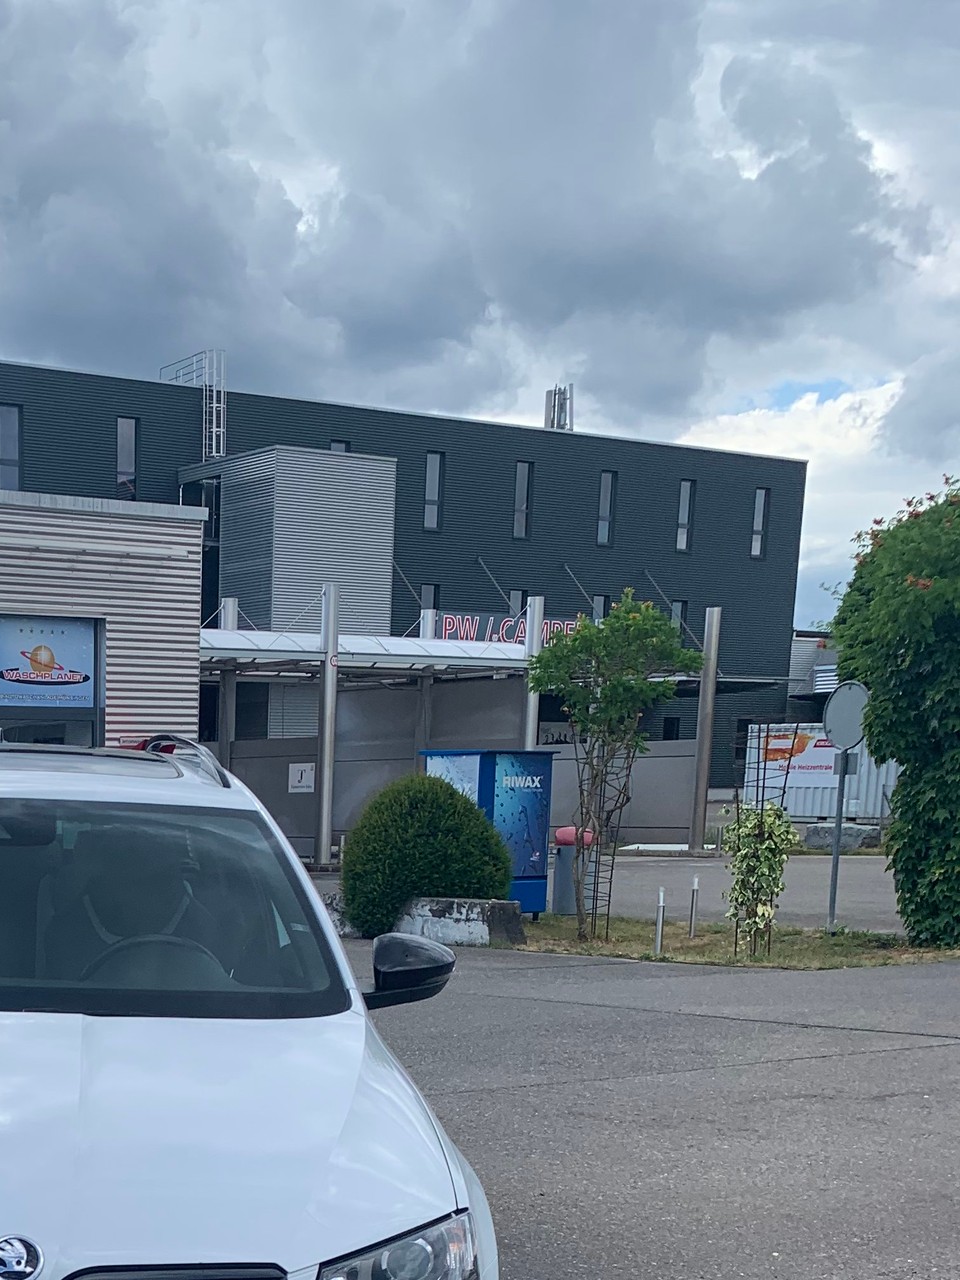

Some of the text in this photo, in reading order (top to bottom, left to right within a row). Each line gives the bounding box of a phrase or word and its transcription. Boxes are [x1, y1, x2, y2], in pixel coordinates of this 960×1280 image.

[442, 614, 480, 642] PW
[2, 670, 85, 682] WASCHPLANET
[502, 775, 541, 788] RIWAX
